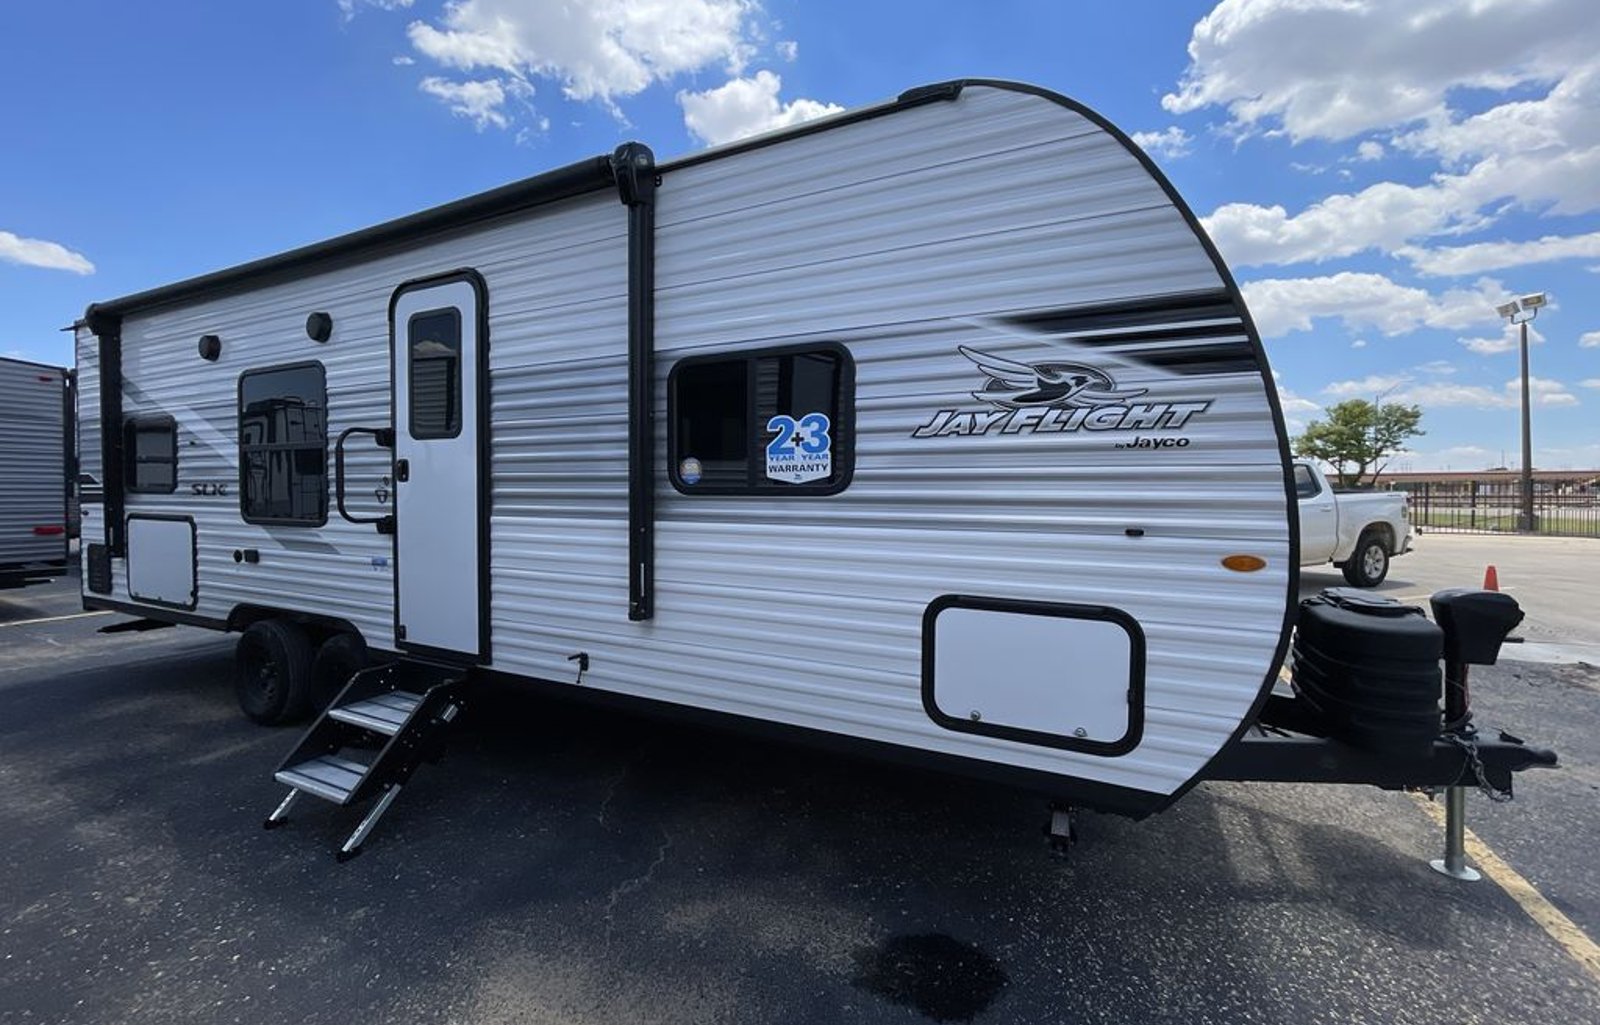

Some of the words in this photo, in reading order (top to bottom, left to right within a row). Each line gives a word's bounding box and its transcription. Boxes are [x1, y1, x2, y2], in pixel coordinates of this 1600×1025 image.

[1125, 436, 1190, 450] Jayco
[801, 453, 828, 461] YEAR
[768, 463, 828, 473] WARRANTY
